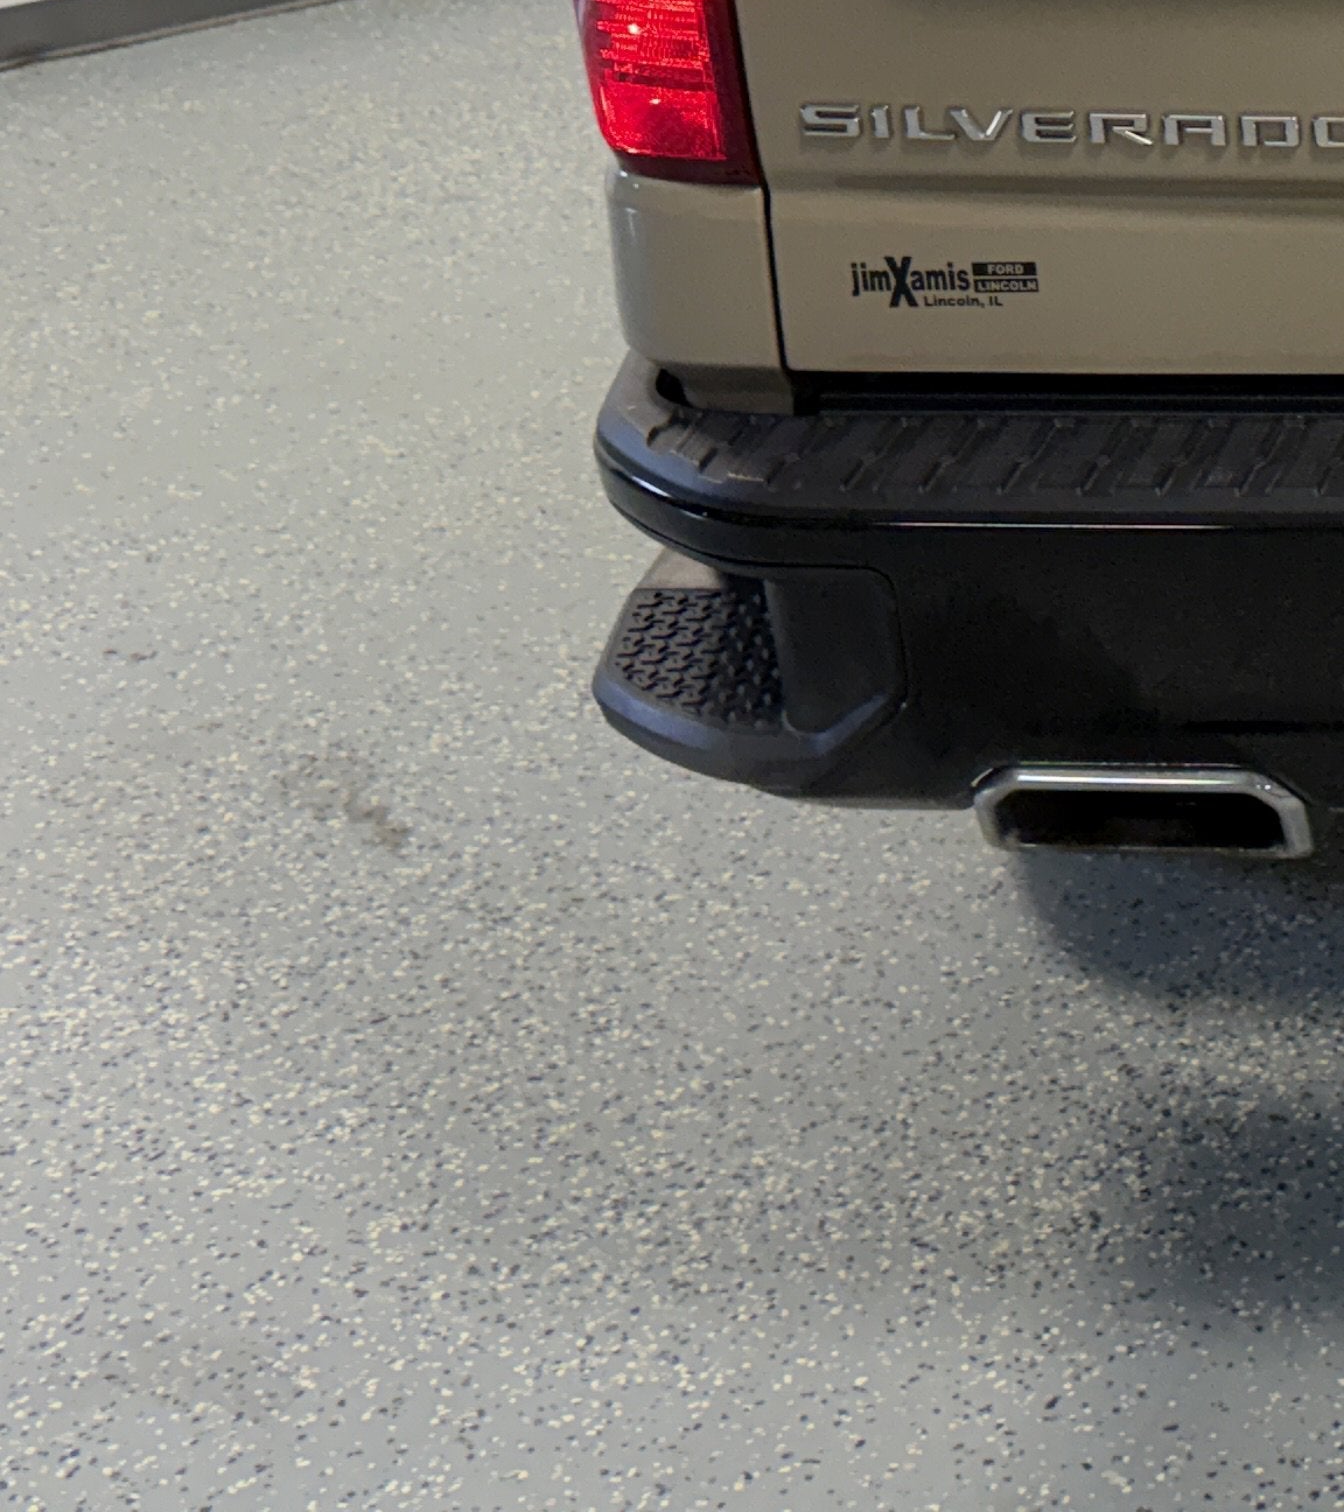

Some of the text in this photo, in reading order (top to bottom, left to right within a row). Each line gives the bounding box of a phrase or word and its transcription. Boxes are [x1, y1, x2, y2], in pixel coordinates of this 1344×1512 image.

[987, 263, 1025, 276] FORD
[976, 279, 1039, 293] LINCOLN
[924, 294, 1004, 309] Lincoln, IL
